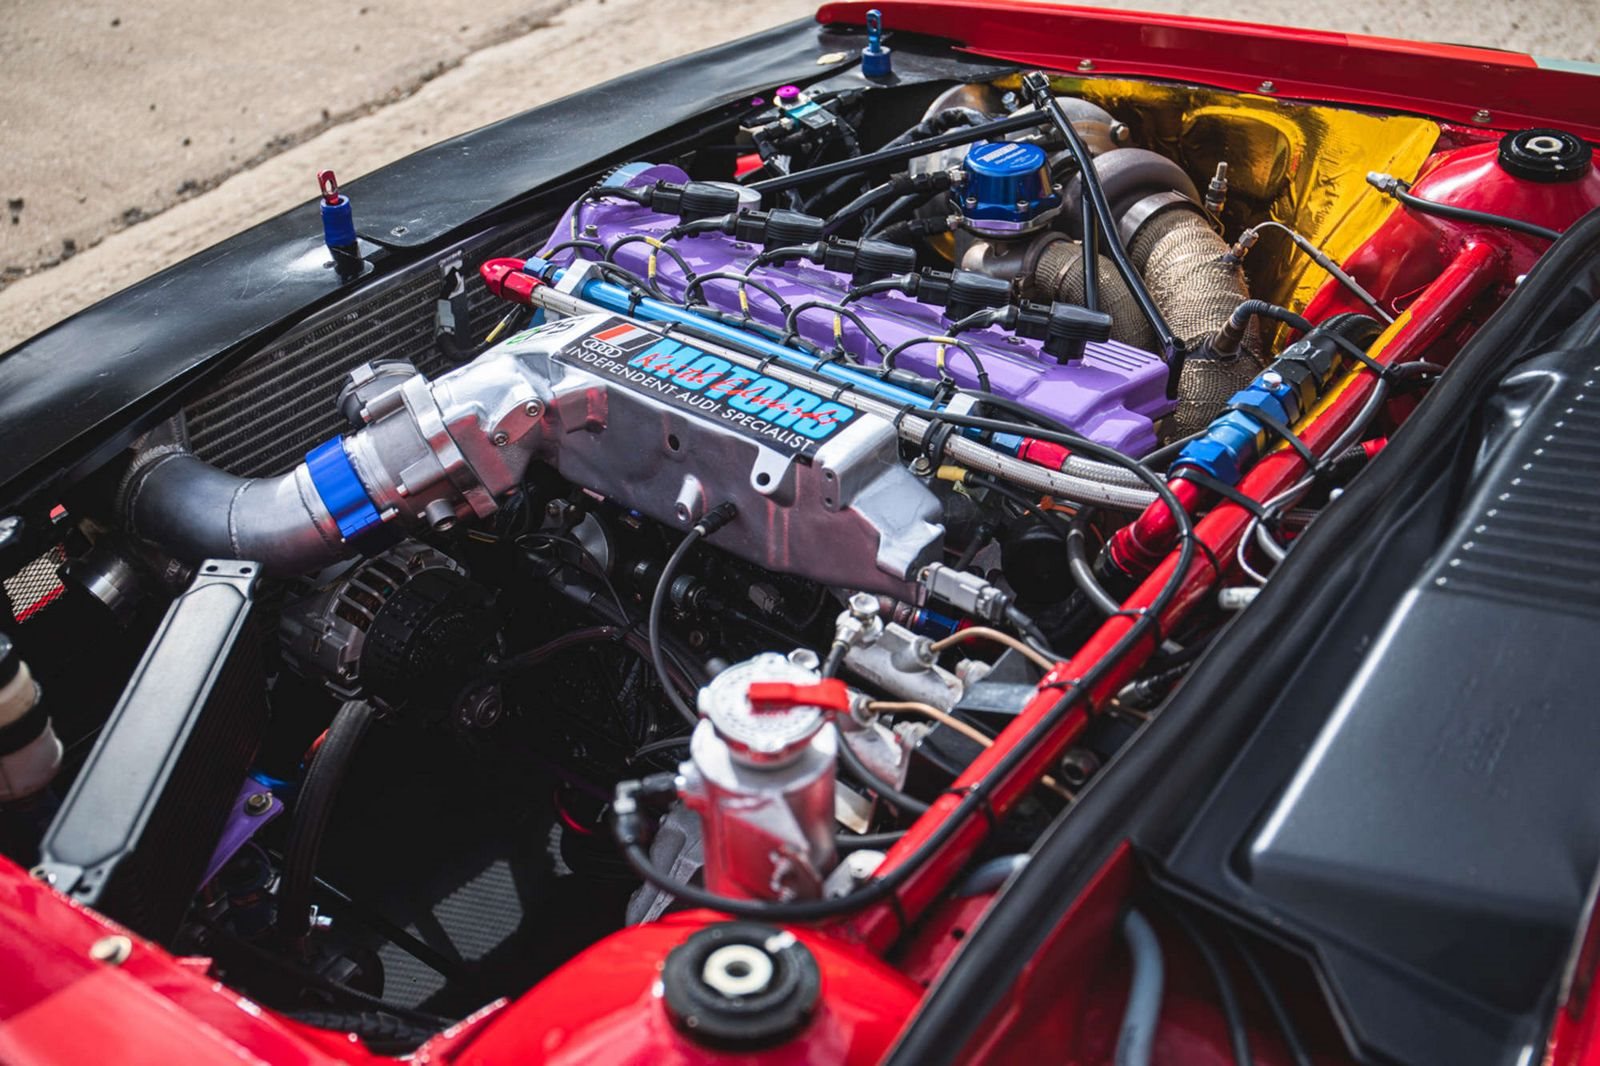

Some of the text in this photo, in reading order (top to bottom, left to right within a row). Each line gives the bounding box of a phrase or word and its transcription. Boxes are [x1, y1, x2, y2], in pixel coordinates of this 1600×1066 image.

[566, 346, 815, 452] INDEPENDENT AUDI SPECIALIST
[627, 338, 855, 440] MOTORS
